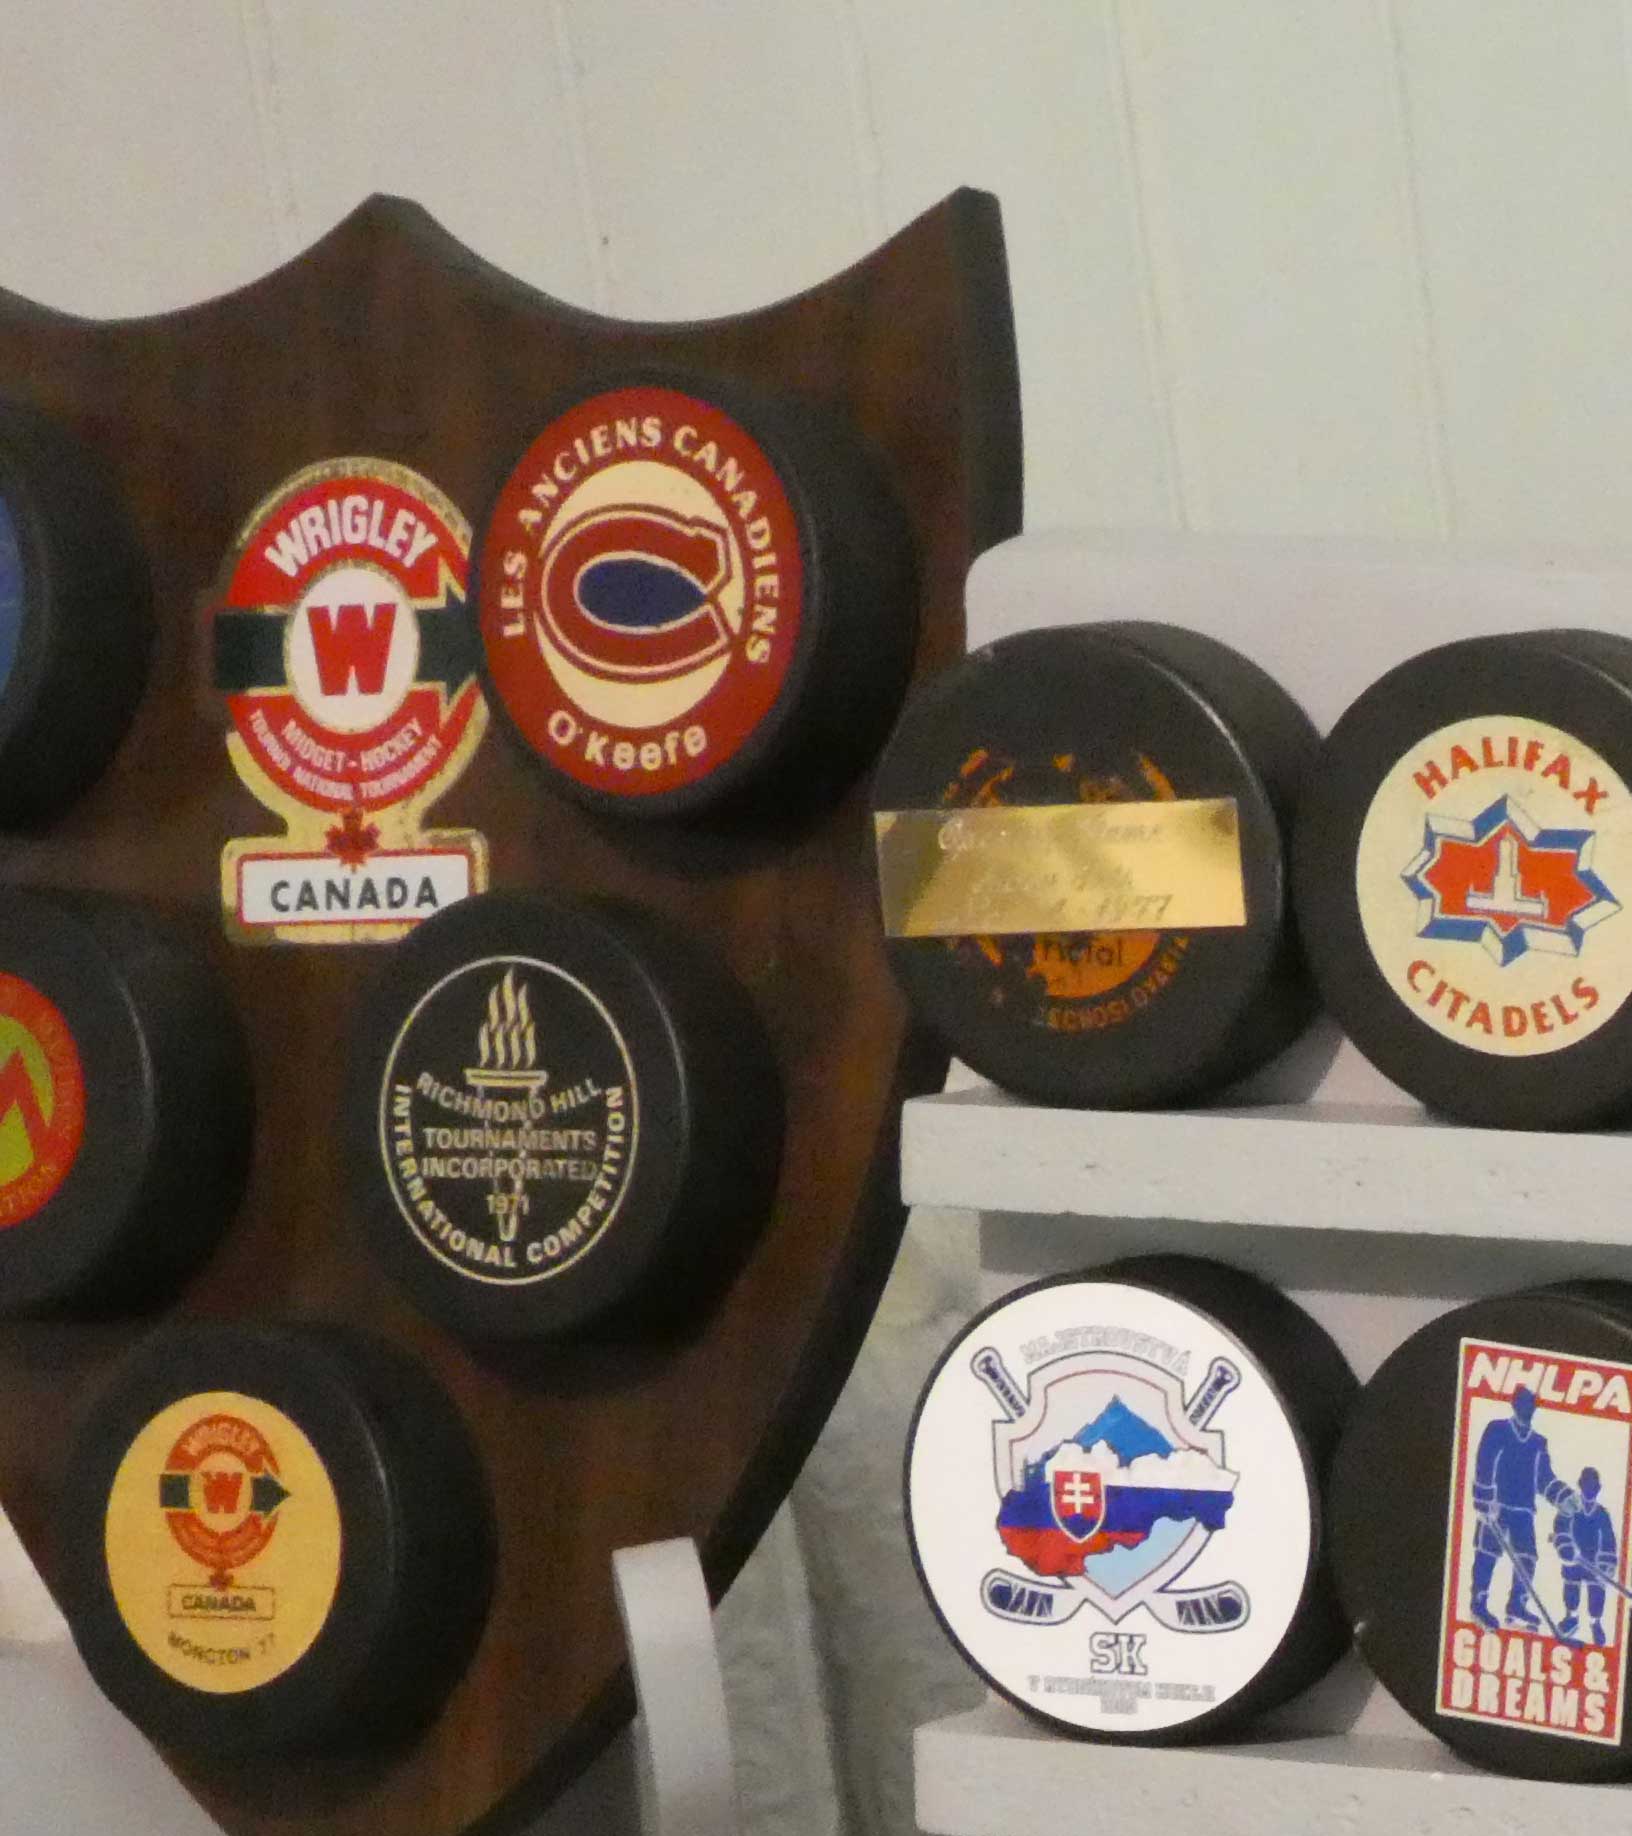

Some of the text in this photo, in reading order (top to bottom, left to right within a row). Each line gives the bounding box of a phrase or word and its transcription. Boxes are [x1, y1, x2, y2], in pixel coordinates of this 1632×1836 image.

[265, 495, 438, 578] WRIGLEY
[501, 416, 780, 664] LES ANCIENS CANADIENS
[307, 603, 397, 696] W
[360, 717, 423, 772] HOCKEY
[1413, 736, 1609, 814] HALIFAX
[270, 874, 440, 913] CANADA
[1407, 959, 1600, 1039] CITADELS
[416, 1071, 602, 1123] RICHMOND HILL
[421, 1157, 598, 1181] INCORPORATED
[423, 1127, 598, 1151] TOURNAMENTS
[393, 1084, 626, 1268] INTERNATIONAL COMPETITION
[1468, 1352, 1631, 1414] NHLPA
[181, 1595, 257, 1612] CANADA
[1089, 1632, 1148, 1675] SK
[1453, 1628, 1609, 1692] GOALS &
[1451, 1669, 1606, 1732] DREAMS
